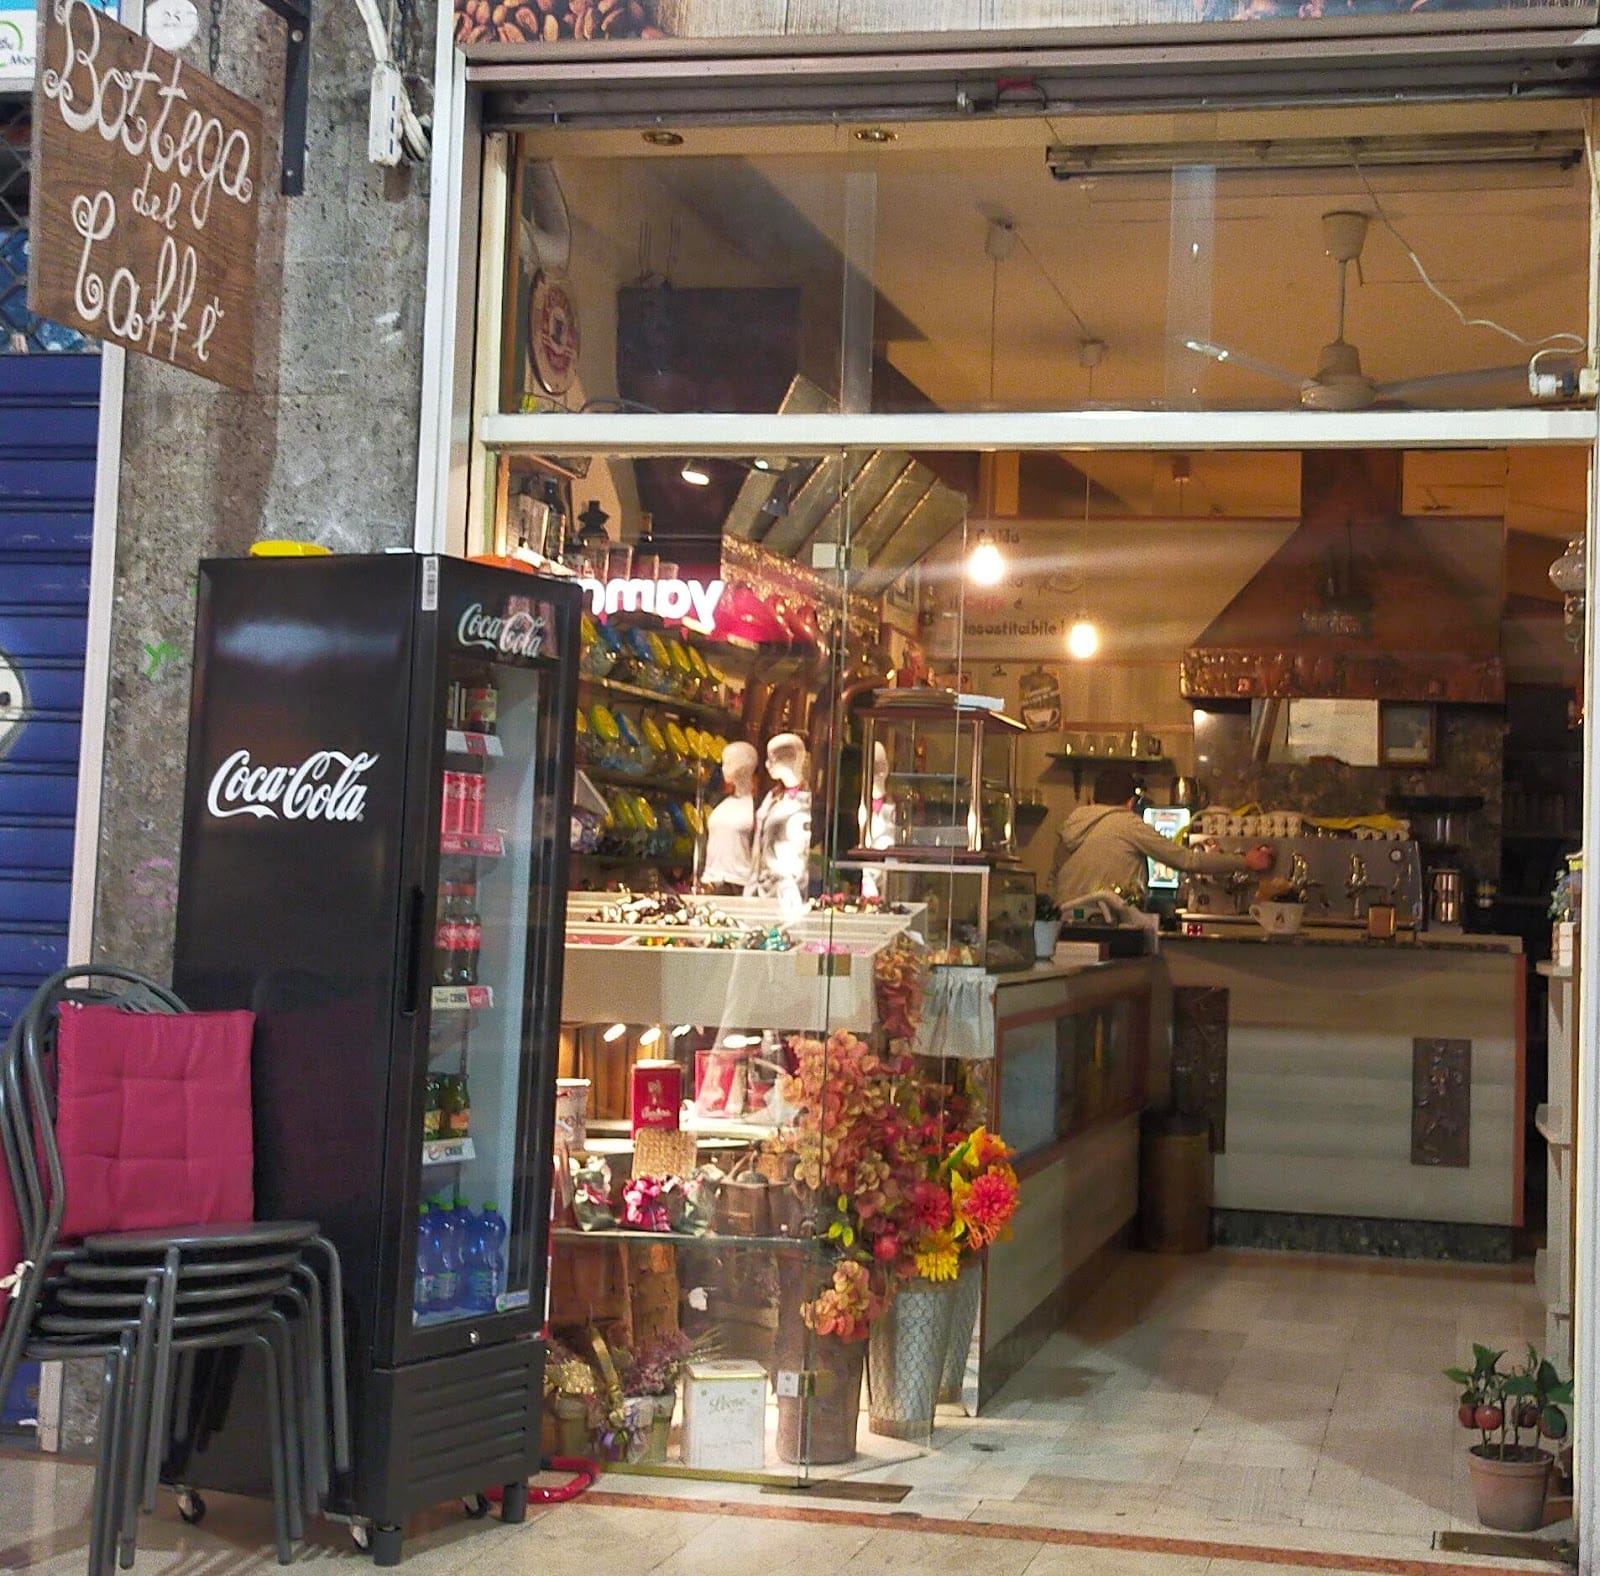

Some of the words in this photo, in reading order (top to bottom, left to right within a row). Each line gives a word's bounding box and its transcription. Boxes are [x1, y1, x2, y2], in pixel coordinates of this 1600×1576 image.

[42, 0, 253, 230] Bottega
[132, 162, 183, 231] del
[457, 602, 546, 659] Coca-Cola
[206, 749, 381, 823] Coca-Cola
